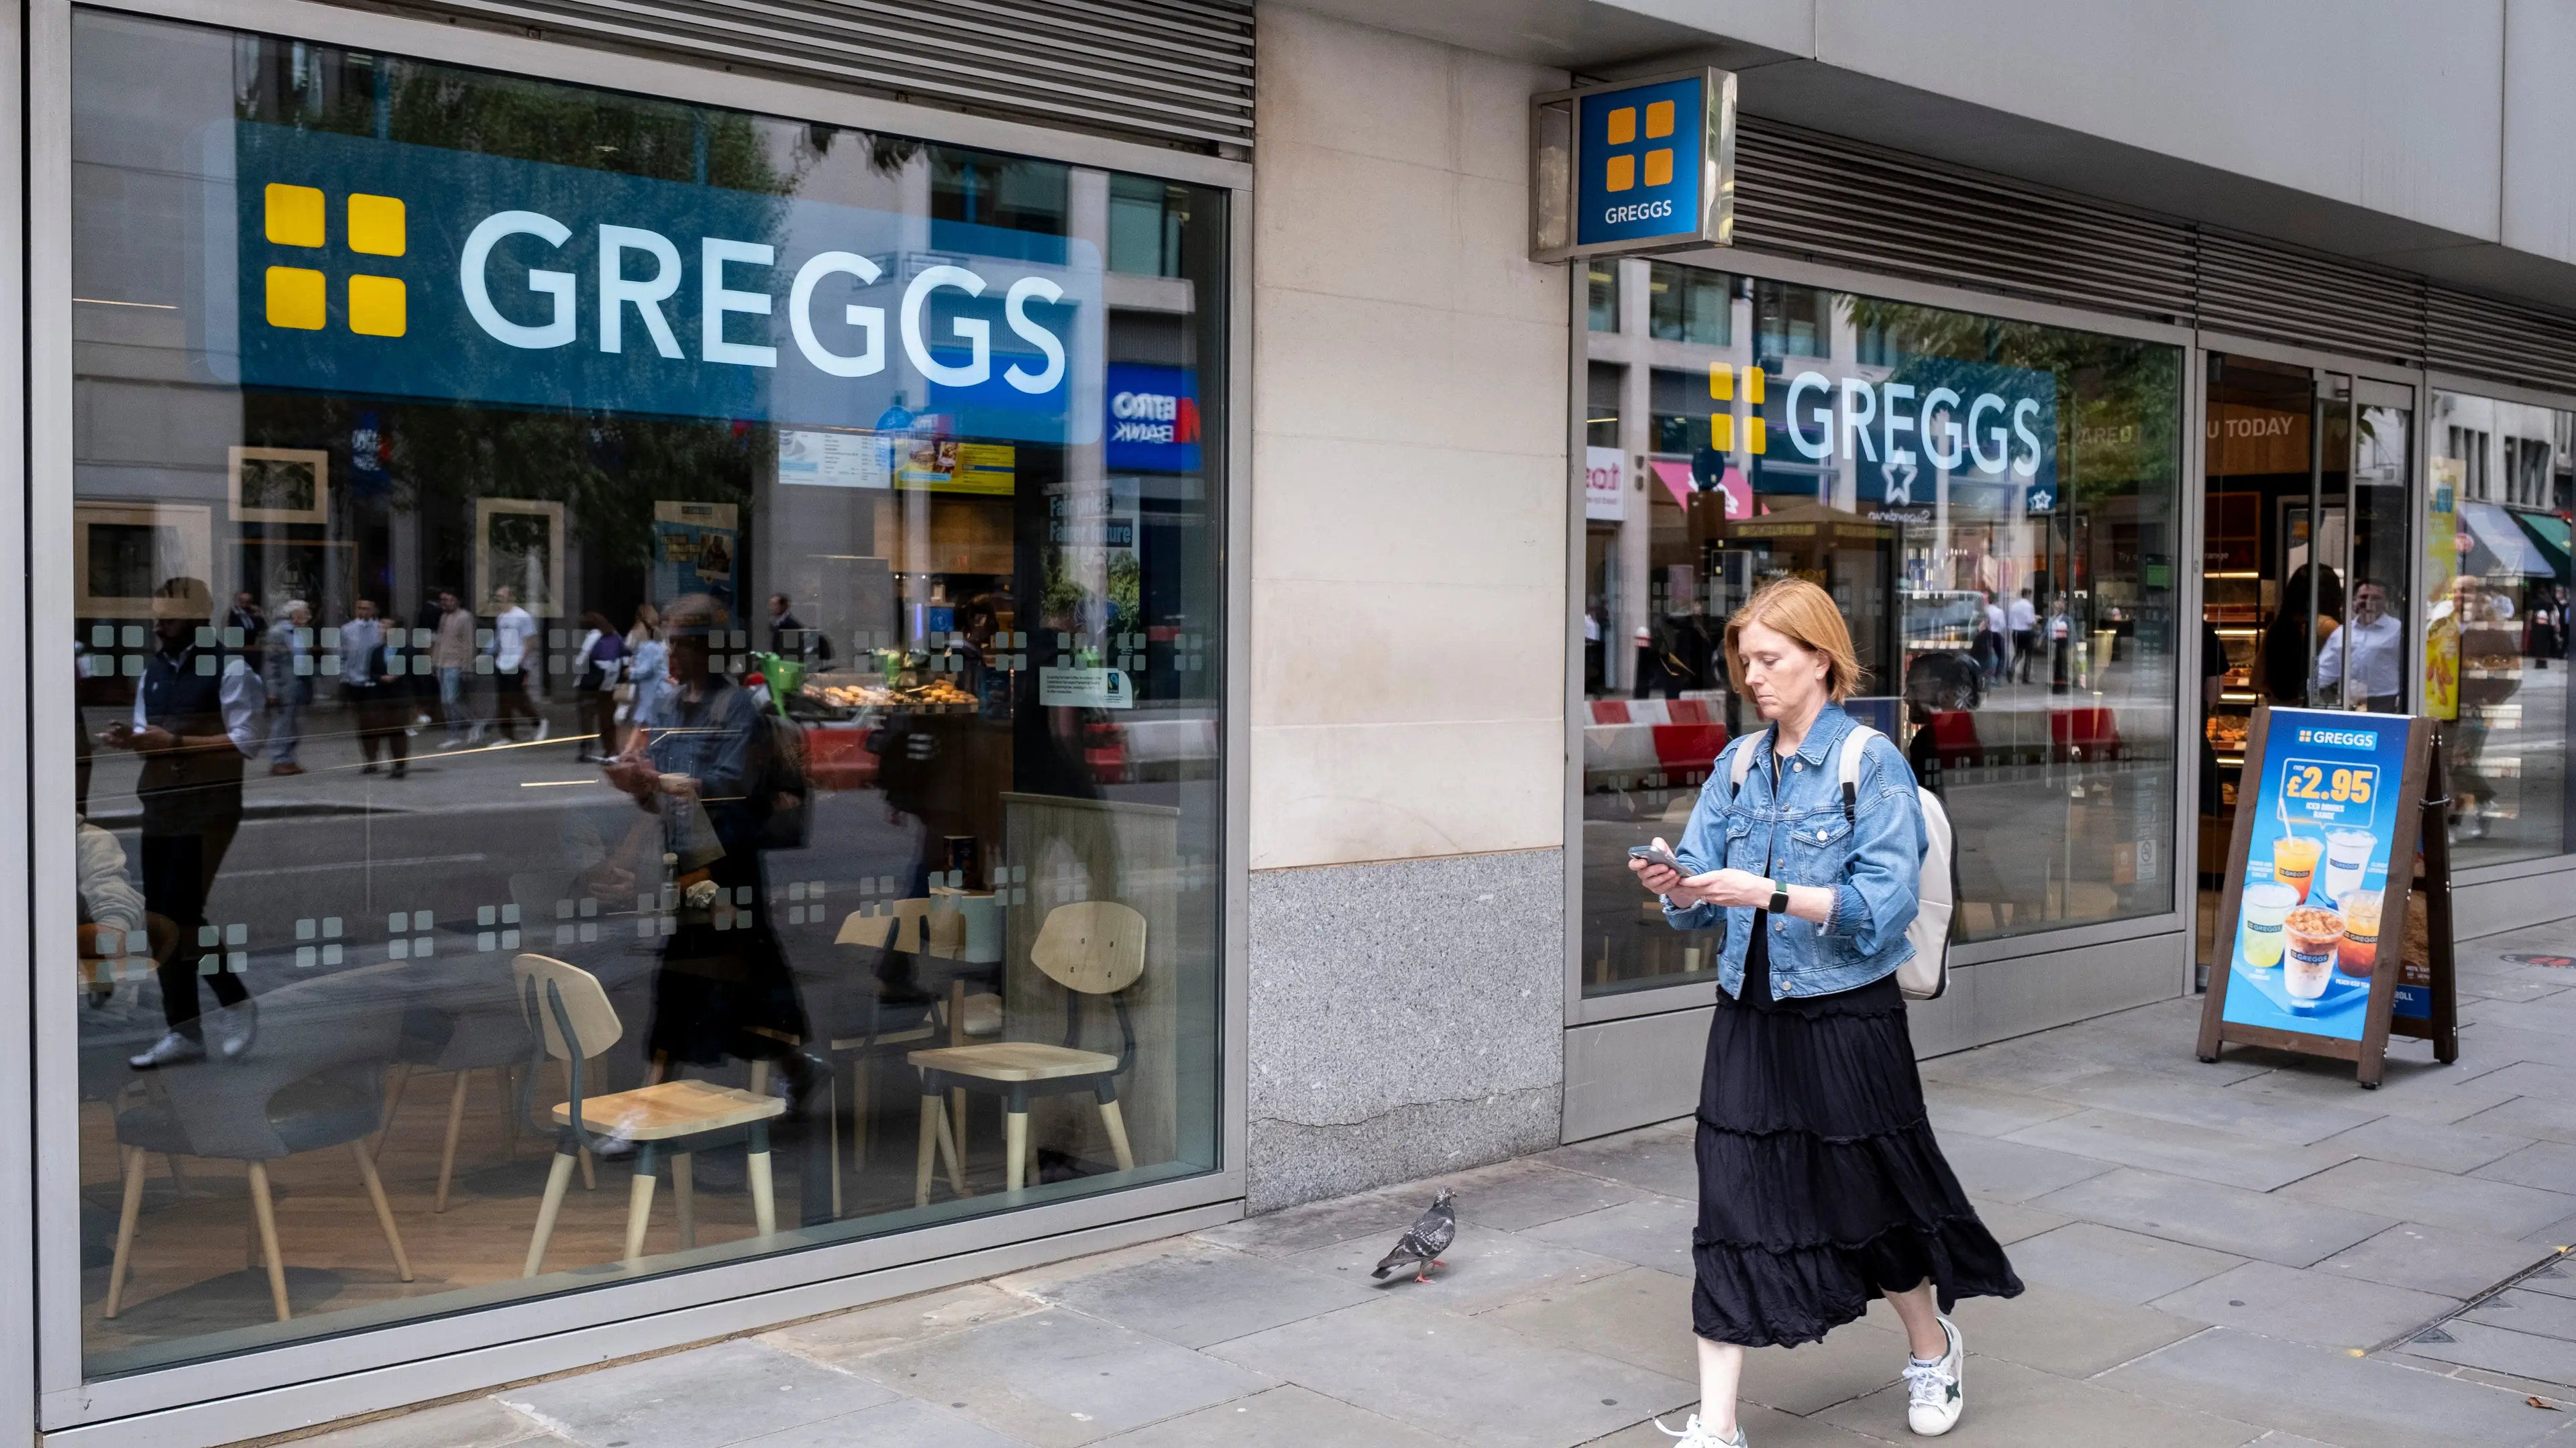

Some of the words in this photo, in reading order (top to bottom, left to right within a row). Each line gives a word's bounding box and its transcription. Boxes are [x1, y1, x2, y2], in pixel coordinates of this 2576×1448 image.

[1605, 199, 1672, 224] GREGGS
[460, 210, 1065, 394] GREGGS
[1786, 371, 2041, 477] GREGGS
[2225, 416, 2294, 437] TODAY
[2314, 731, 2373, 746] GREGGS
[2287, 767, 2373, 803] £2.95
[2297, 953, 2328, 962] GREGGS
